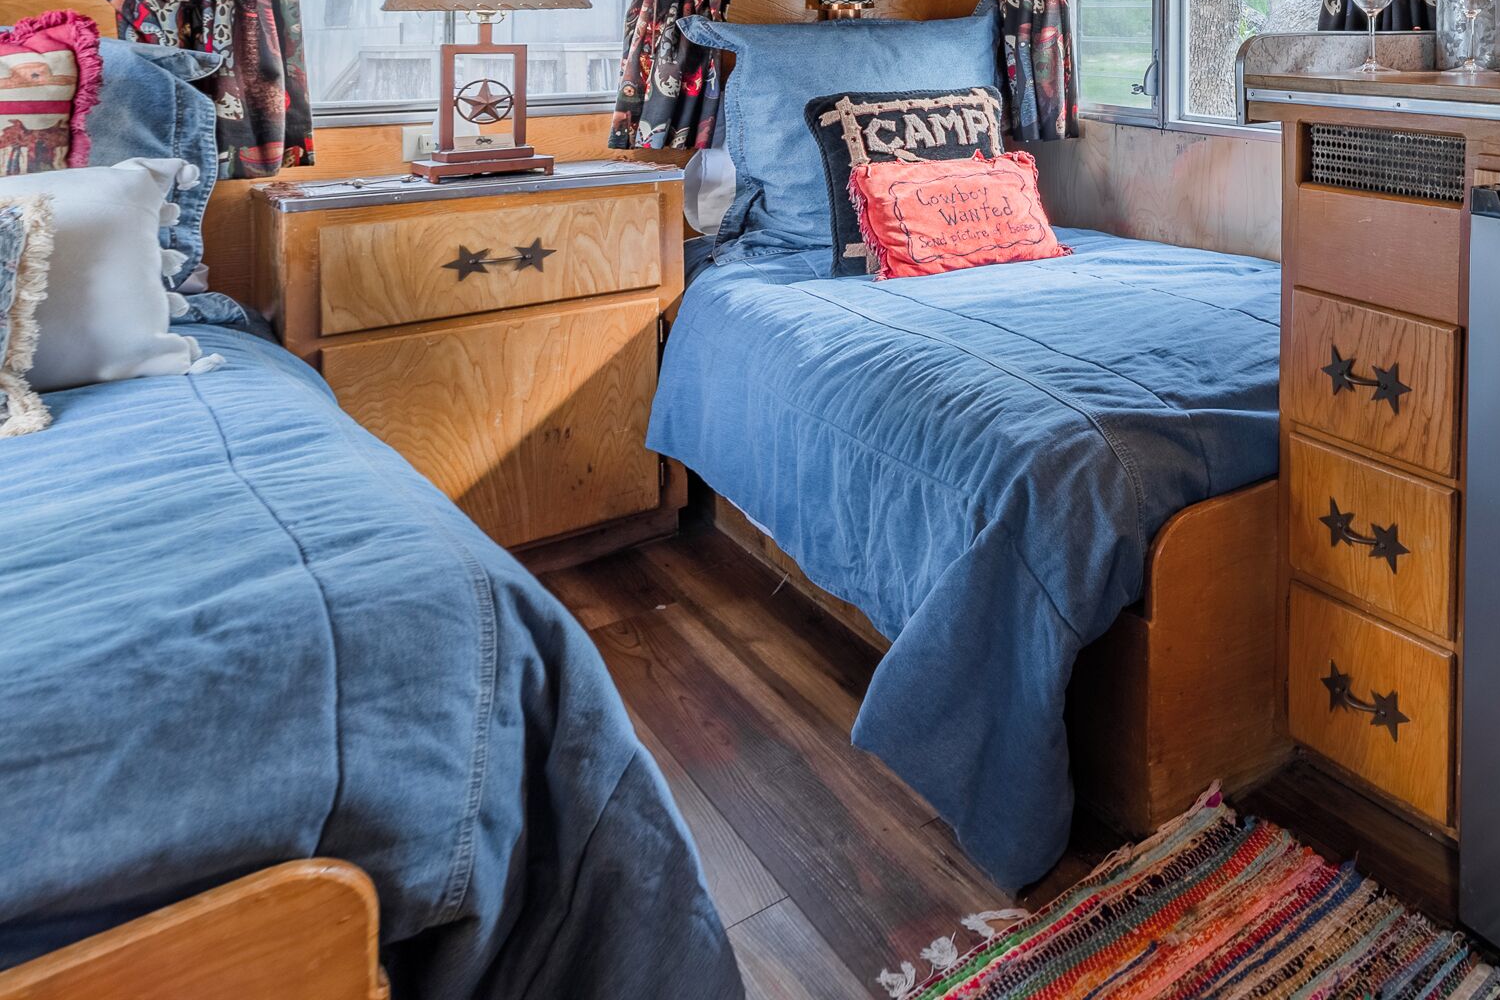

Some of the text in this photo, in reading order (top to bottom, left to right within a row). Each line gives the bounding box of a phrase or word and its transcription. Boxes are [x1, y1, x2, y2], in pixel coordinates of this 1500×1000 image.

[866, 108, 989, 152] CAMP
[916, 184, 987, 207] Cowboy
[951, 229, 989, 246] picture
